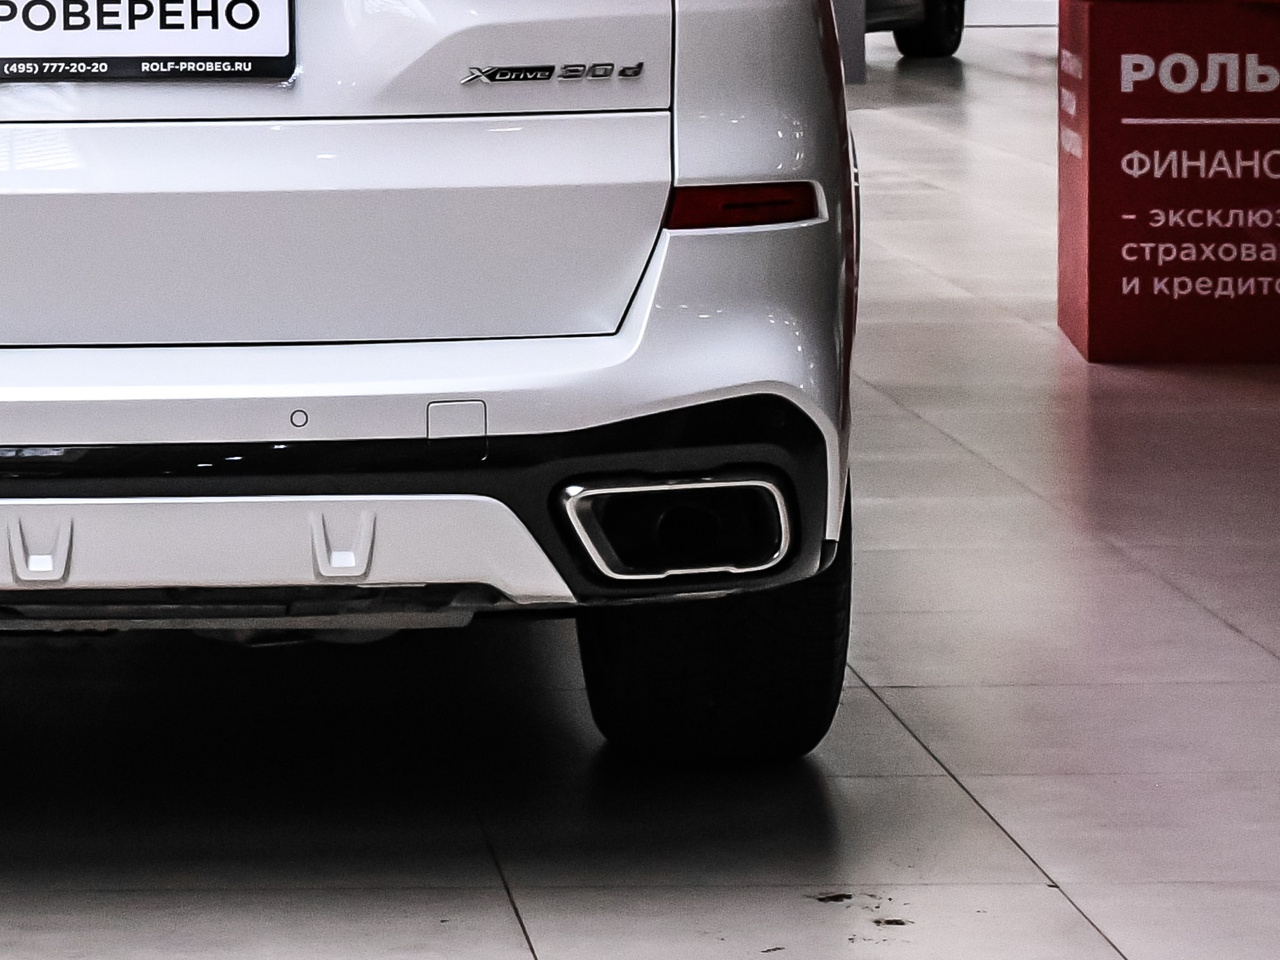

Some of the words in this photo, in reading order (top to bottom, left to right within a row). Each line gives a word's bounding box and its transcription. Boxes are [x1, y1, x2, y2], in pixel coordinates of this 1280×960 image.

[3, 62, 39, 74] (495)
[42, 62, 108, 73] 777-20-20
[141, 61, 252, 72] ROLF-PROBEG.RU
[1120, 53, 1280, 93] РОЛЬ
[1121, 243, 1277, 266] страхова
[1122, 277, 1140, 295] и
[1153, 276, 1280, 299] кредит
